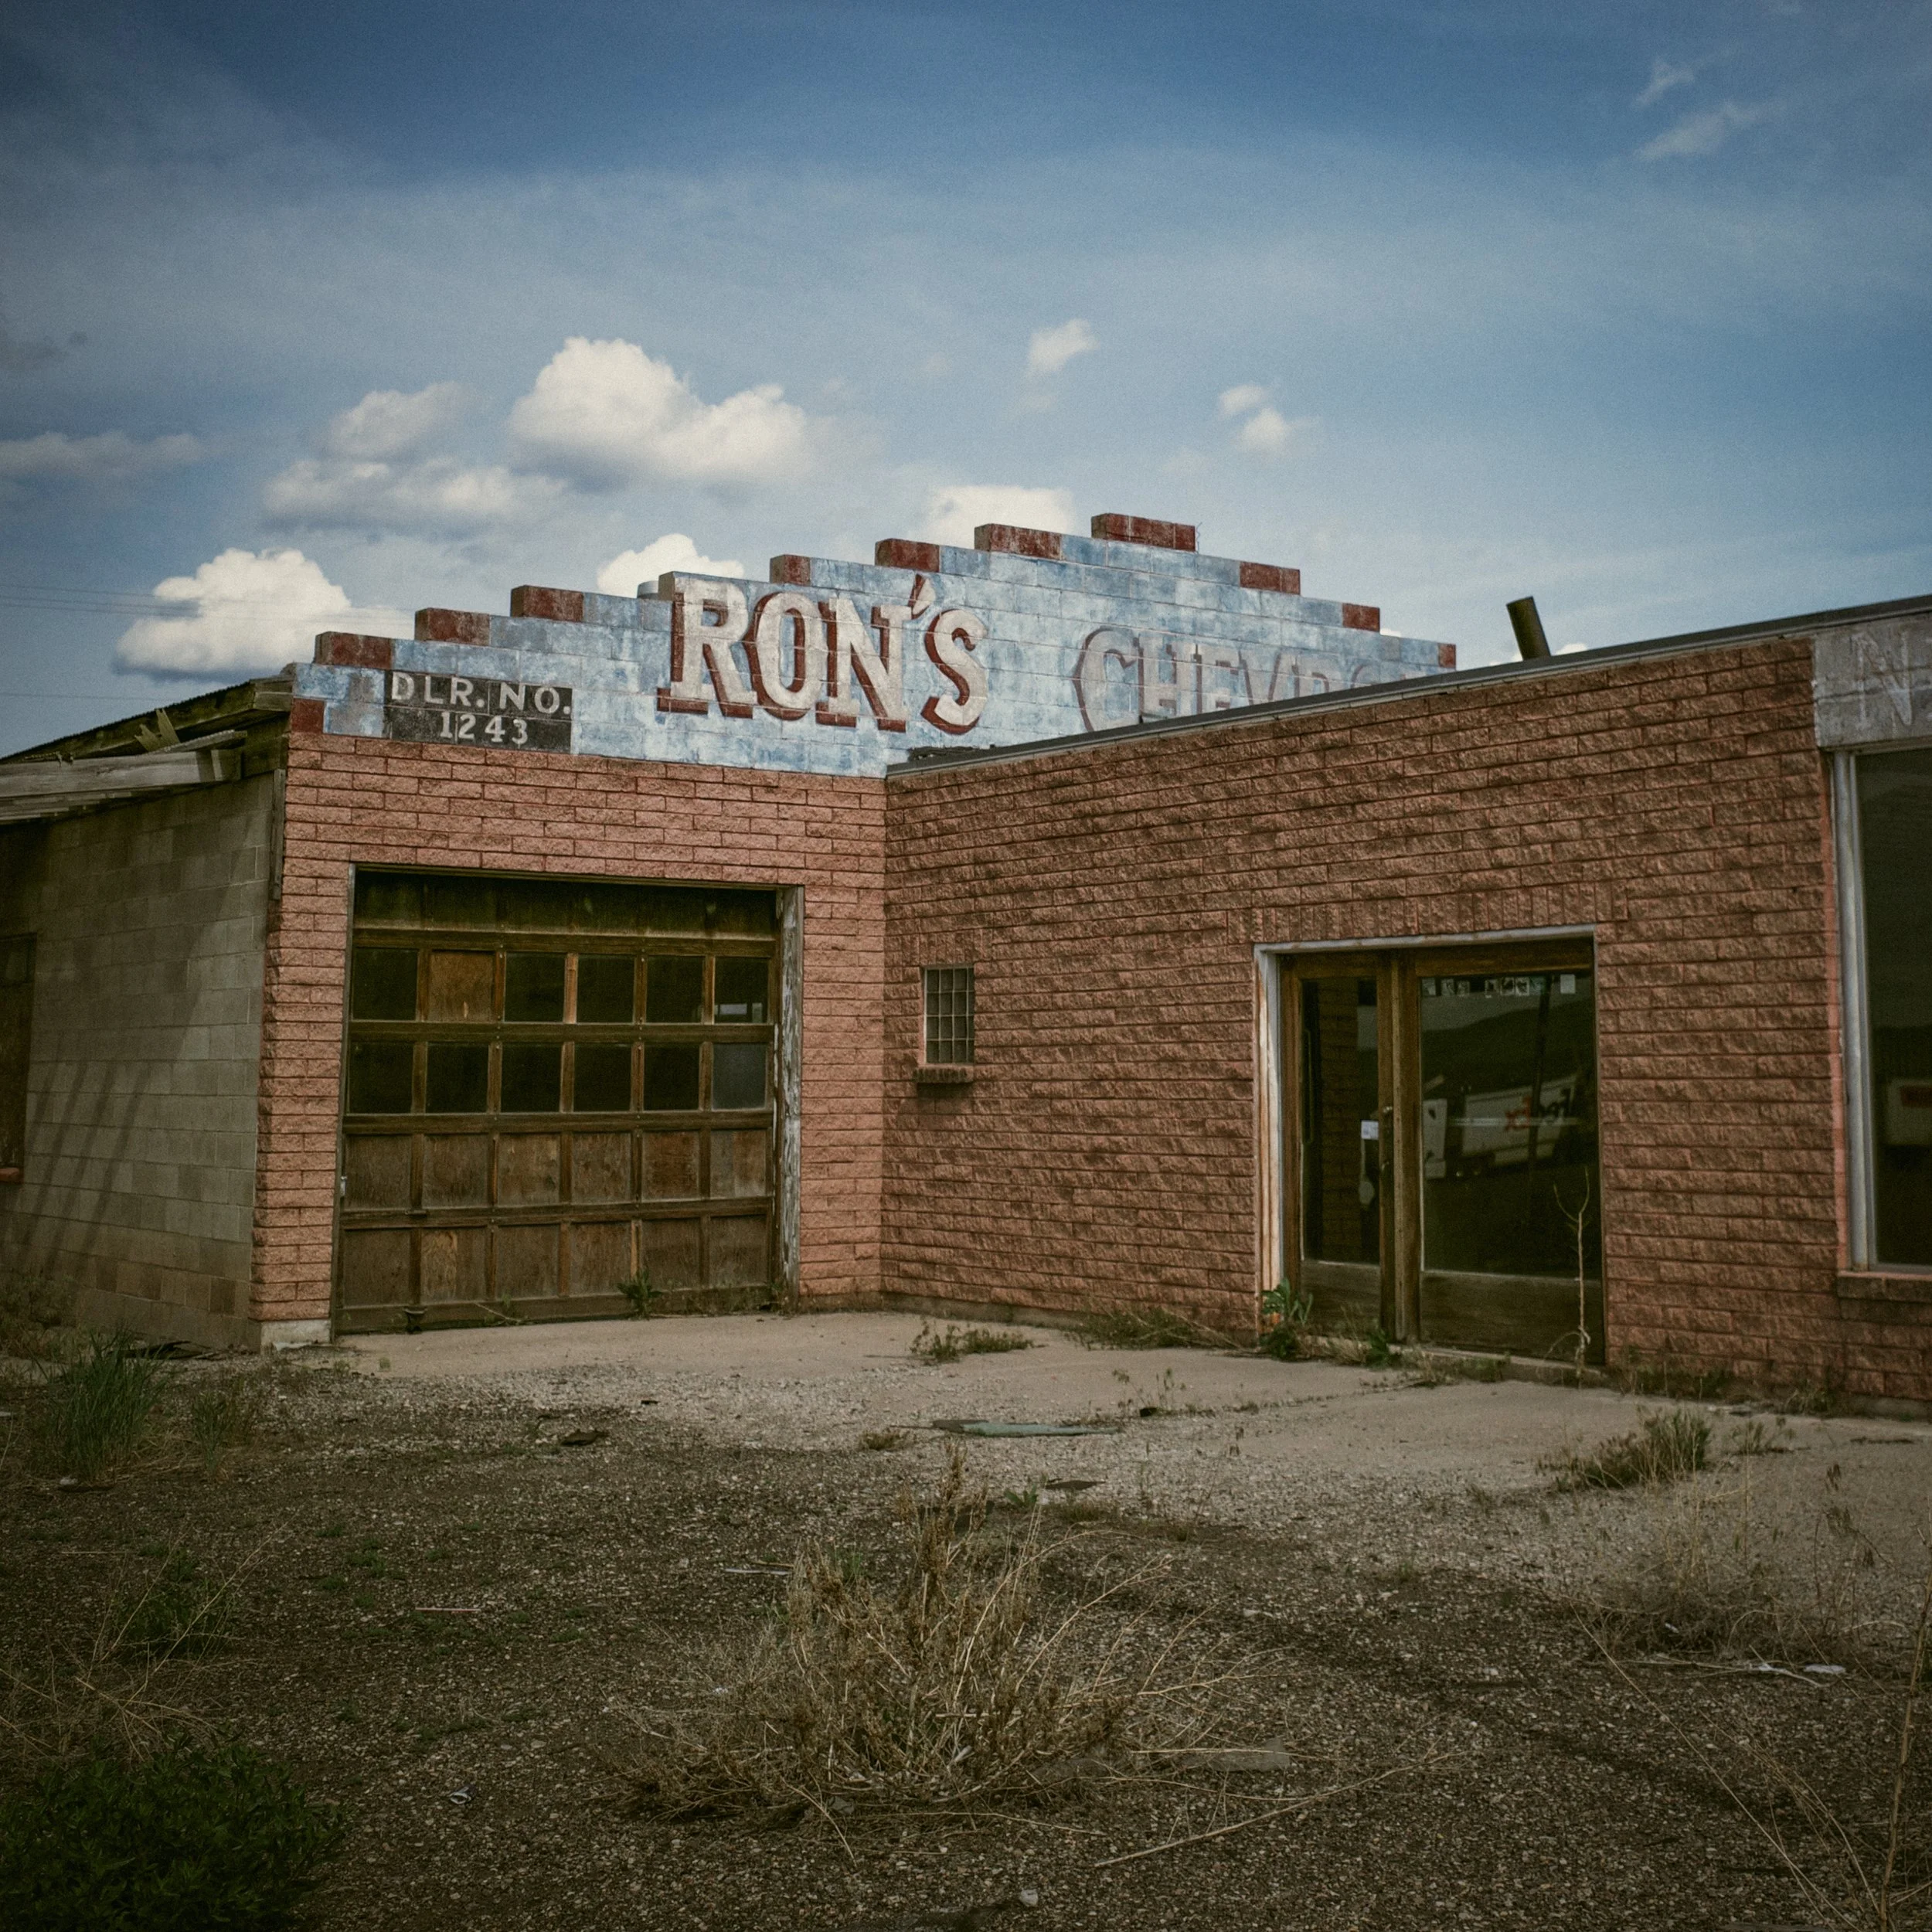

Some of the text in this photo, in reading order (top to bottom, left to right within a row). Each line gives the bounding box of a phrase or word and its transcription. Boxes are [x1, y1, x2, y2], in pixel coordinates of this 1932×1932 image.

[657, 574, 990, 735] RON'S
[391, 671, 572, 715] DLR. NO.
[439, 711, 529, 745] 1243
